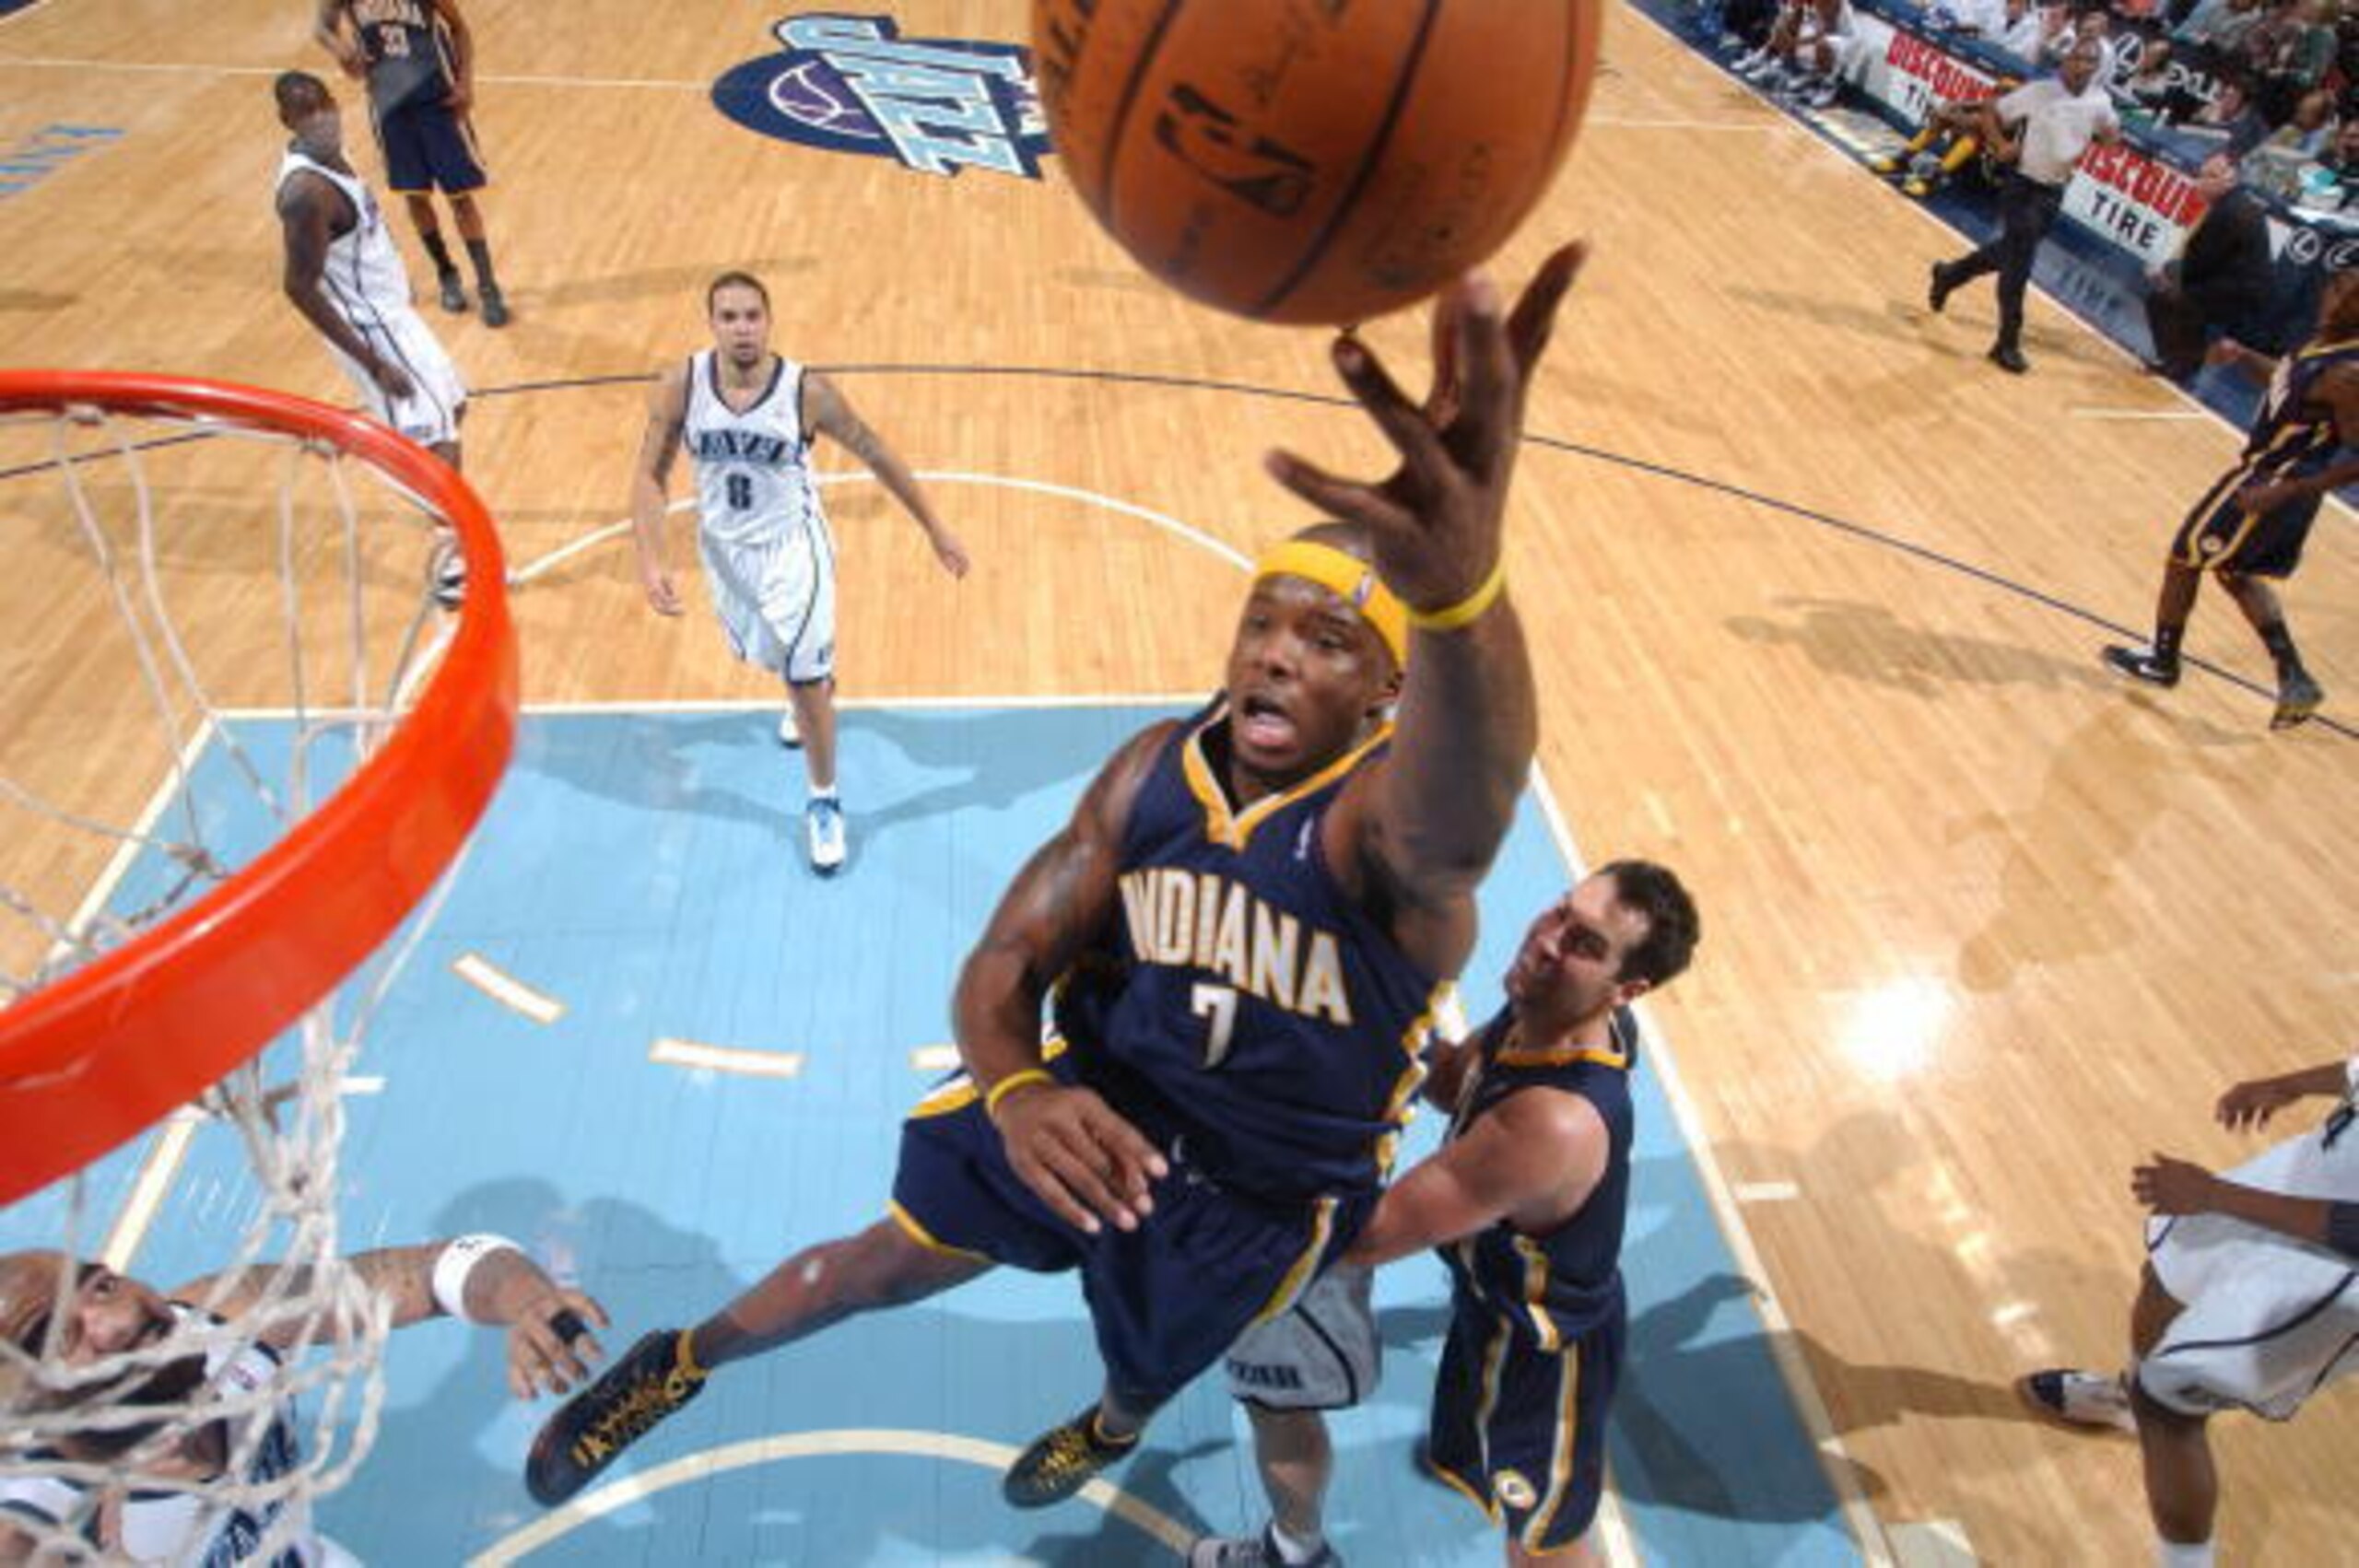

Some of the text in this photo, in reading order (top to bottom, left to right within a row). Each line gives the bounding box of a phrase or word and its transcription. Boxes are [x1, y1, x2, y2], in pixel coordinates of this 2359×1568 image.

[777, 16, 1026, 176] JAZZ
[2092, 190, 2158, 249] TIRE
[726, 472, 752, 511] 8
[1191, 982, 1238, 1071] 7
